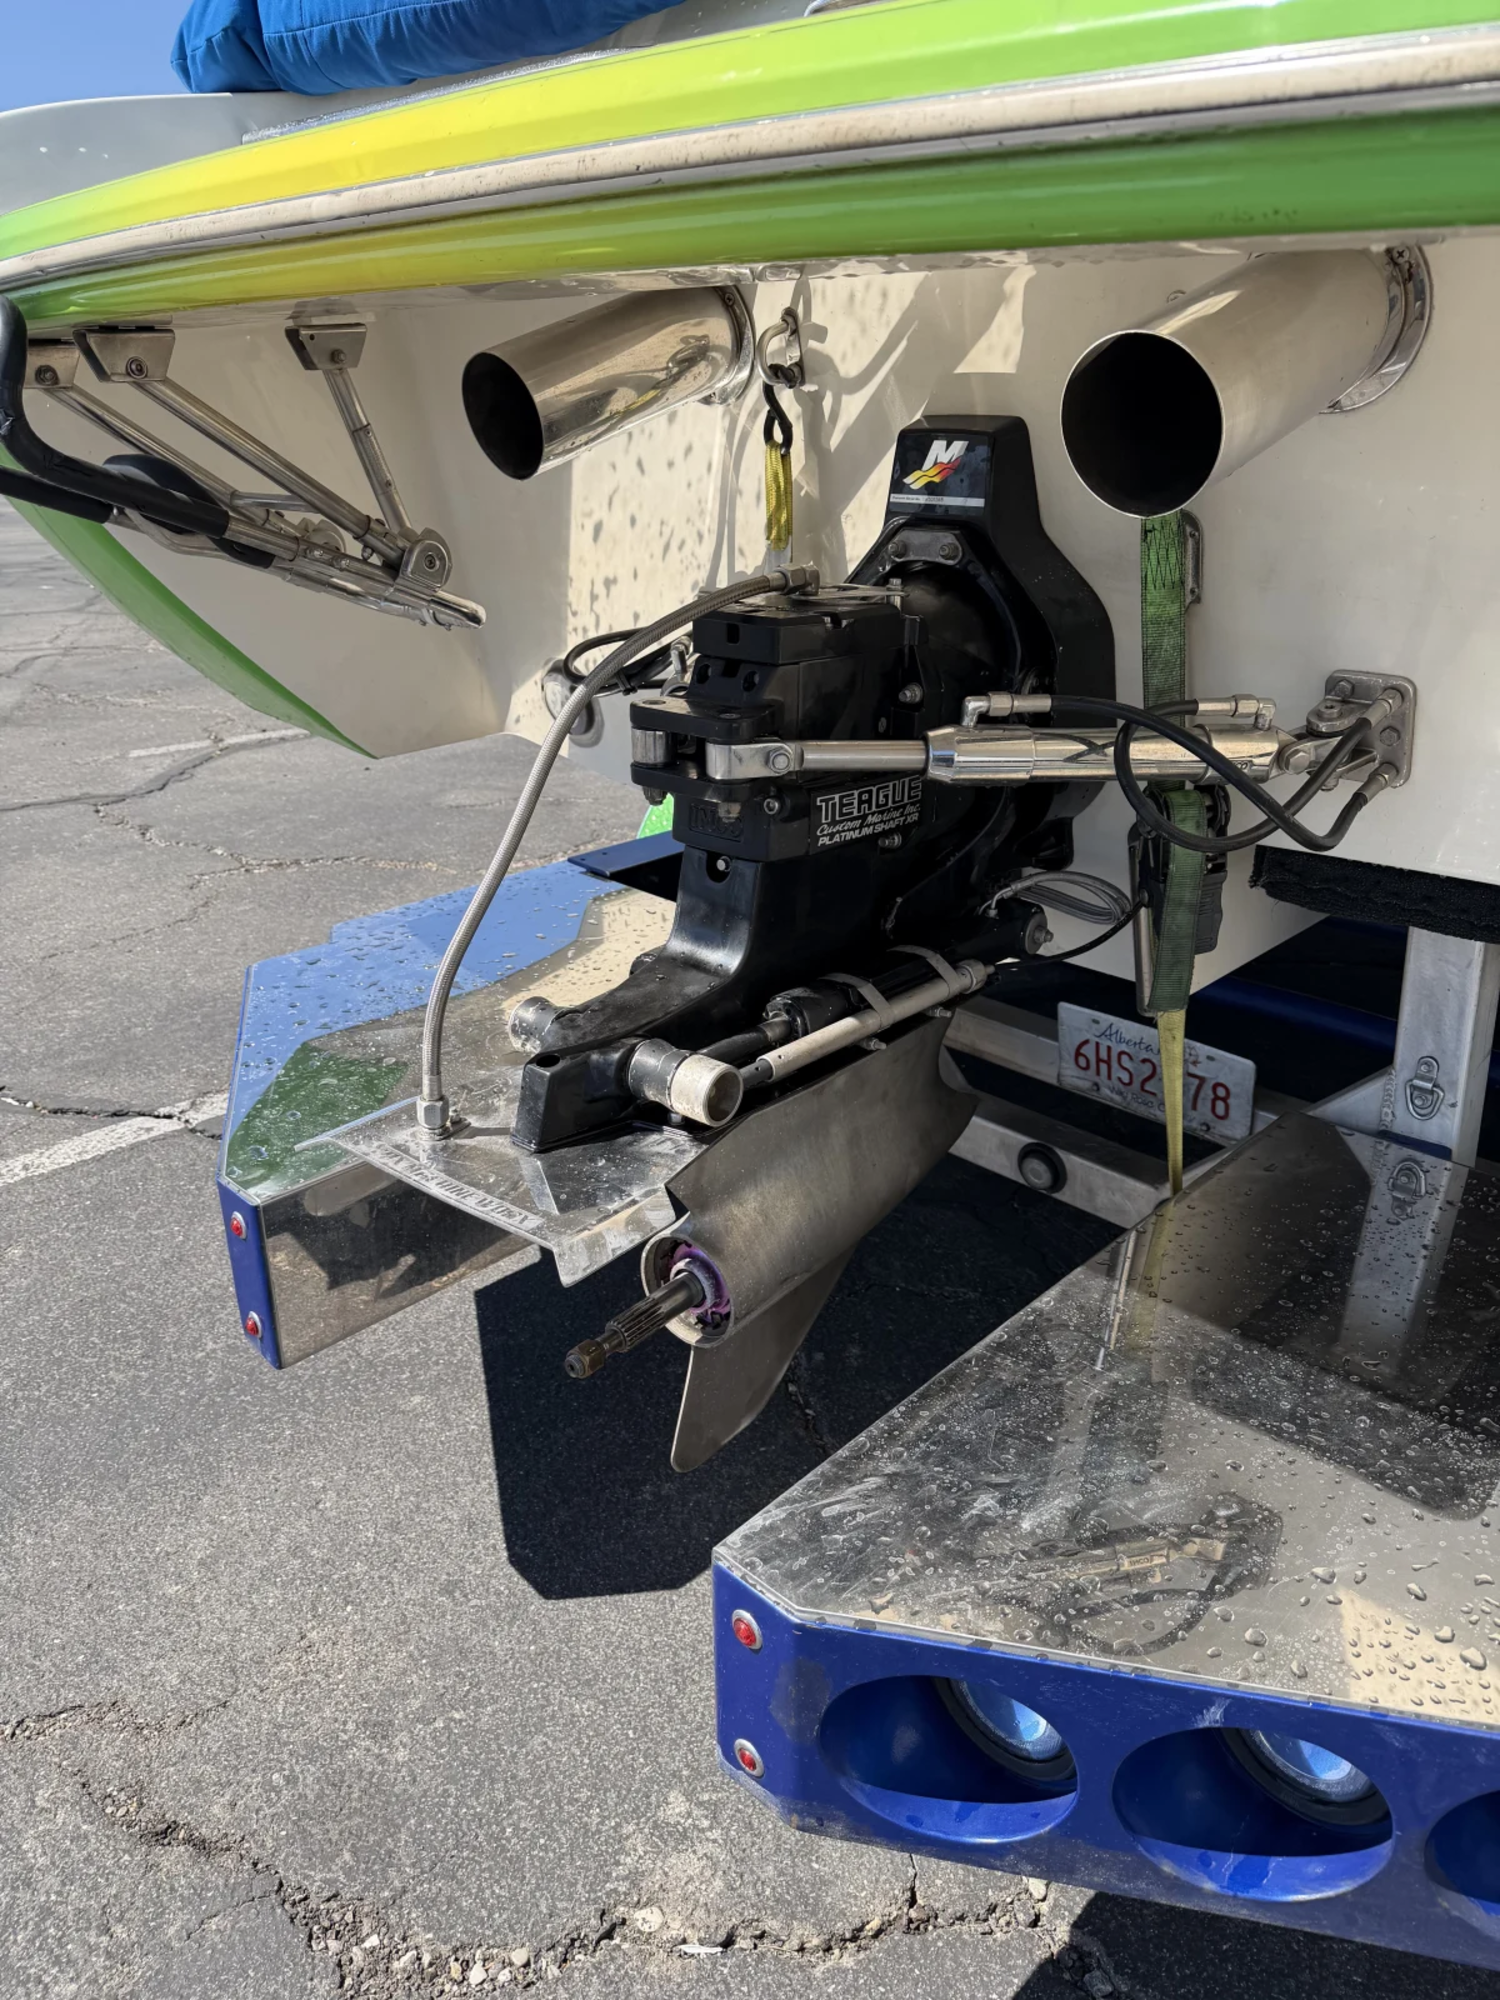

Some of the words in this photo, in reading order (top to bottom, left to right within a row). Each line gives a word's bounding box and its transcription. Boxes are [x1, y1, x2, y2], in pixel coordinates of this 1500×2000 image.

[817, 775, 922, 823] TEAGUE
[816, 820, 861, 836] Custom
[864, 808, 902, 826] Marine
[904, 803, 921, 815] Inc.
[817, 825, 873, 847] PLATINUM
[874, 817, 905, 833] SHAFT
[905, 812, 919, 825] XR
[1094, 1023, 1160, 1055] Alberta
